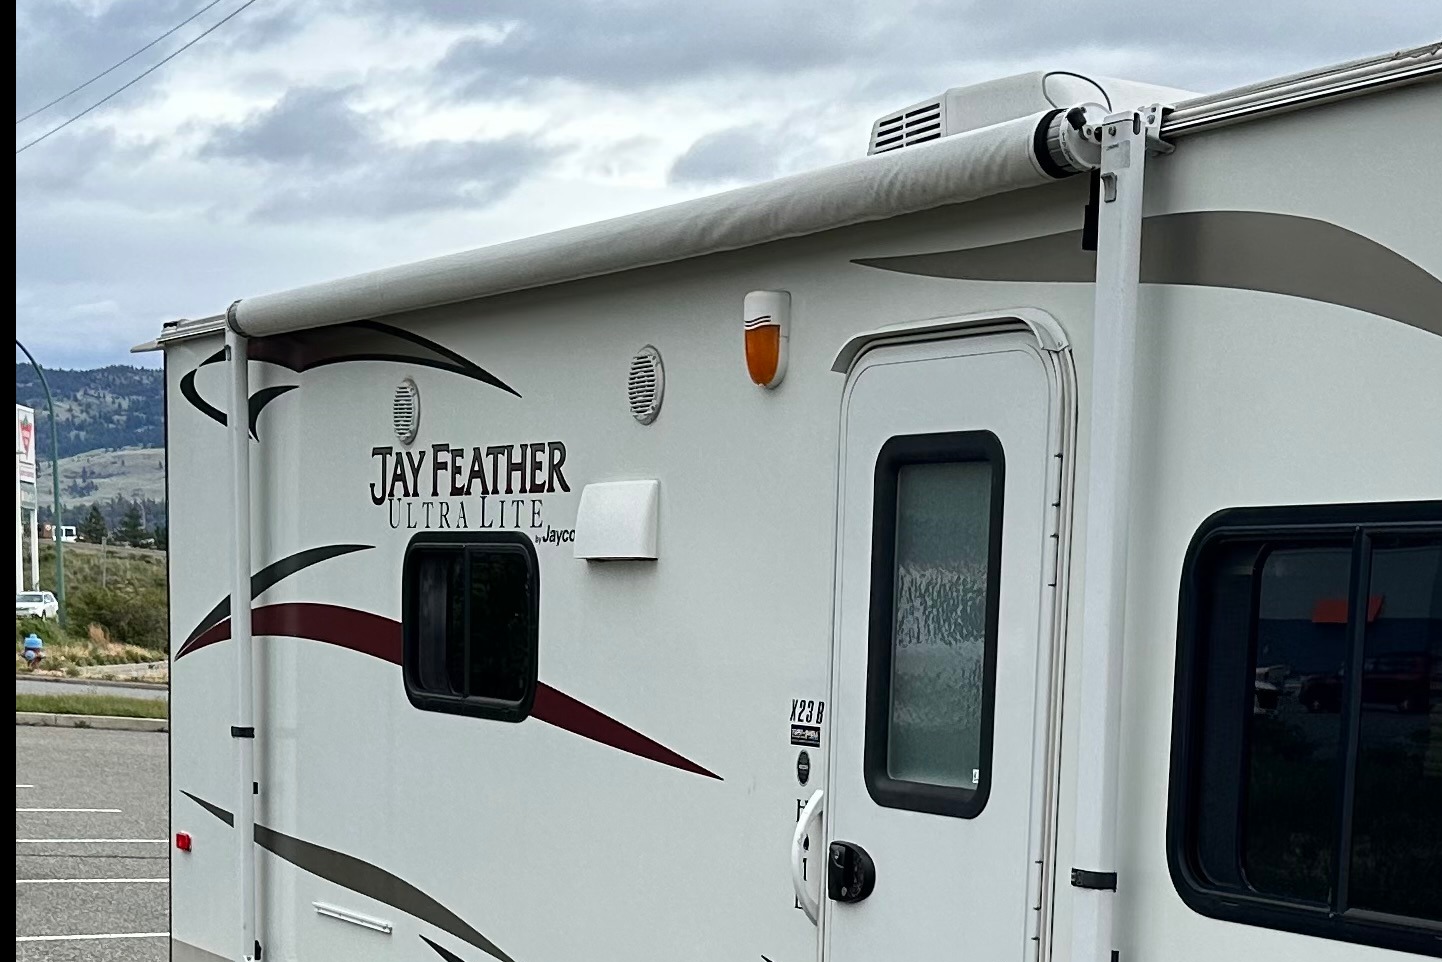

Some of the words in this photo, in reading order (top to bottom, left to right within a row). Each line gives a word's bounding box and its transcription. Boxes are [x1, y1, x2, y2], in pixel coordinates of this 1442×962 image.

[370, 446, 426, 506] JAY
[431, 441, 571, 497] FEATHER
[388, 497, 469, 529] ULTRA
[479, 495, 544, 529] LITE
[542, 524, 575, 546] Jayco
